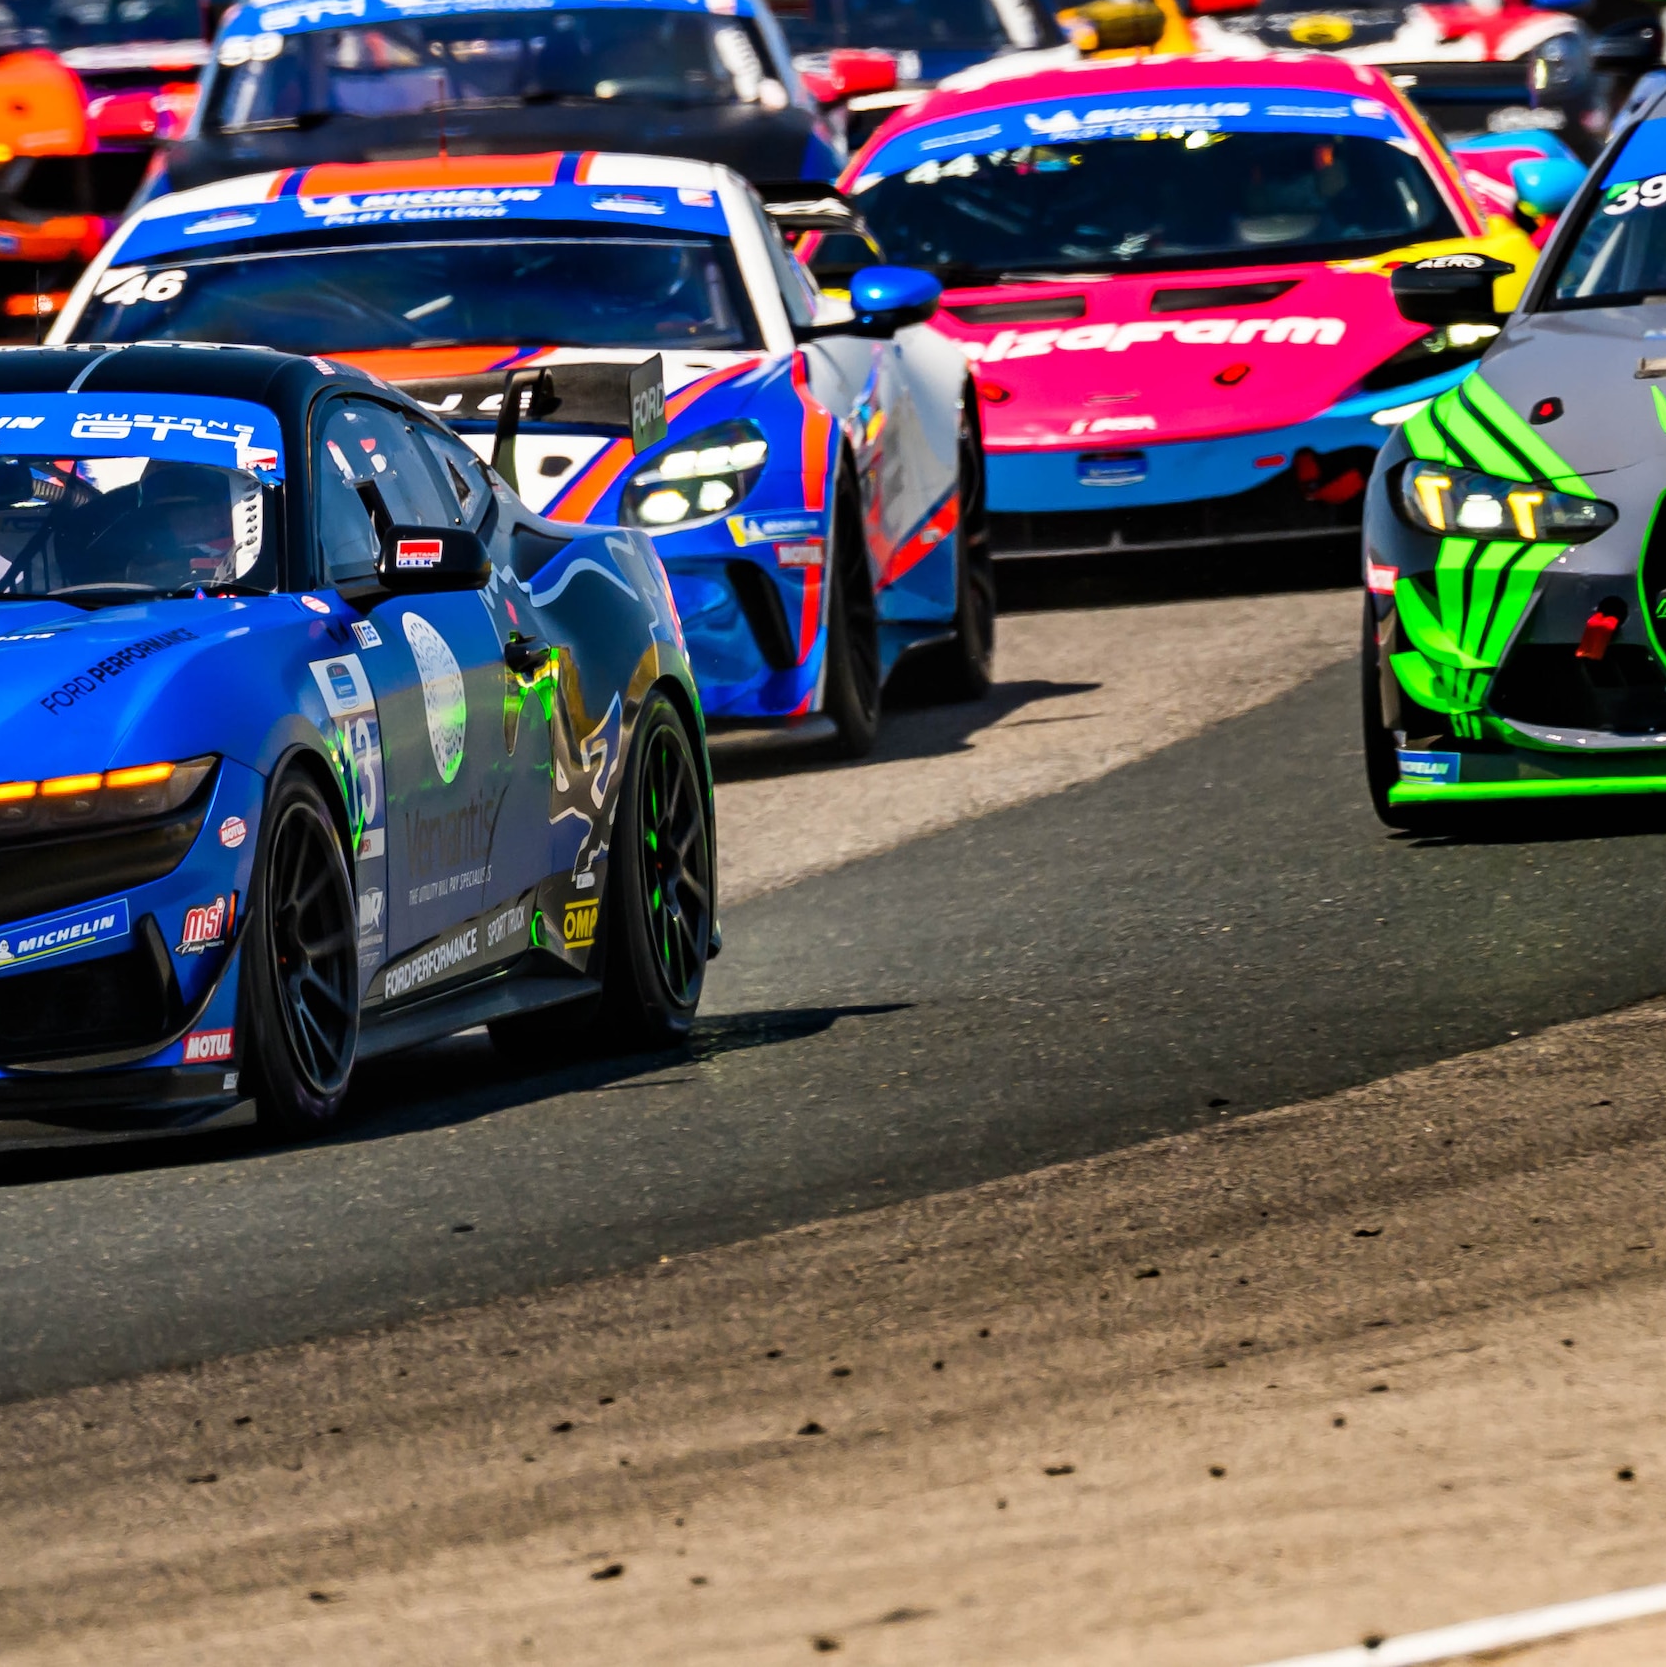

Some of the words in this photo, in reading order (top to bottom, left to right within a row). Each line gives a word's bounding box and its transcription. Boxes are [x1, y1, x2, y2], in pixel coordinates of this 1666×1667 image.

[633, 382, 664, 432] FORD
[40, 676, 97, 716] FORD
[84, 627, 201, 684] PERFORMANCE
[17, 915, 115, 954] MICHELIN
[564, 907, 598, 940] OMP
[385, 966, 411, 999] FORD
[411, 928, 478, 986] PERFORMANCE
[186, 1033, 232, 1059] MOTUL
